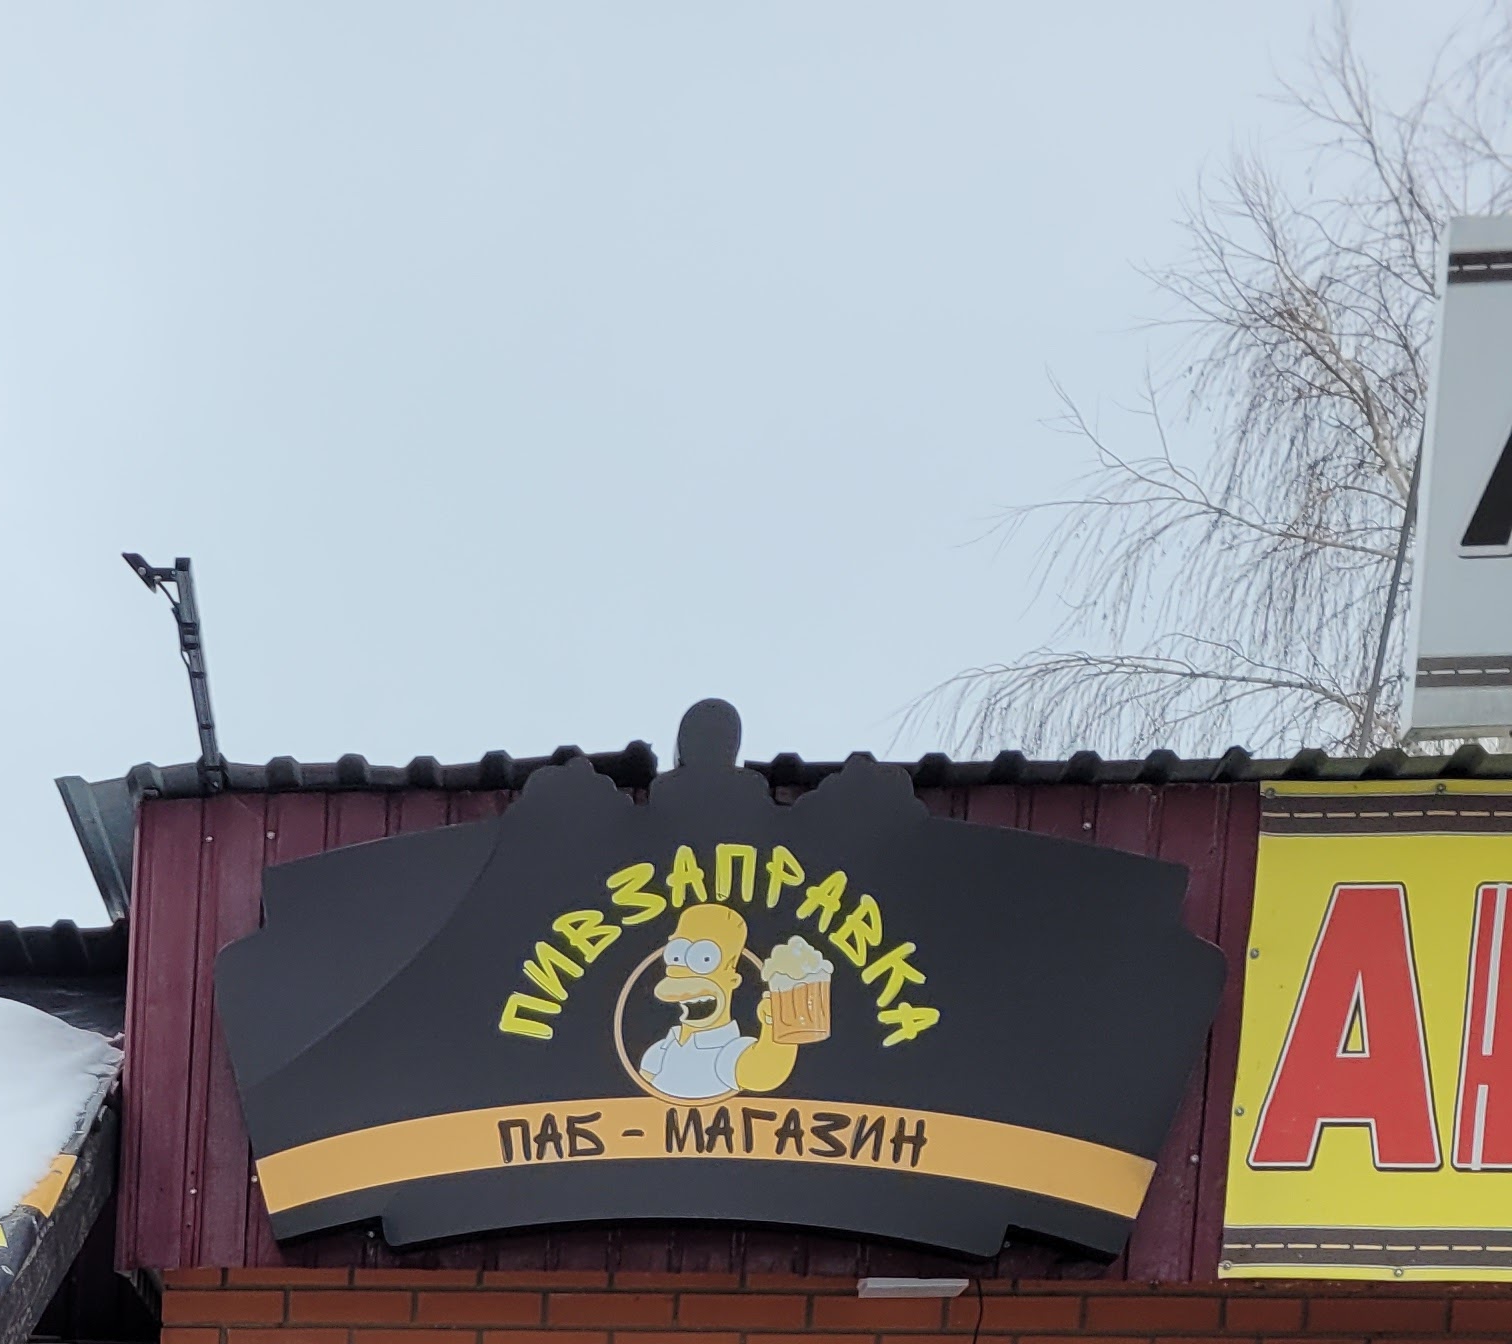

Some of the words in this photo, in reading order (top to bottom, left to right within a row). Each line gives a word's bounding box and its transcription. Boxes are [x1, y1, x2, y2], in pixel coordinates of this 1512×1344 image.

[498, 843, 941, 1047] ПИВЗАПРАВКА
[498, 1111, 606, 1163] ПАБ
[665, 1107, 928, 1168] МАГАЗИН
